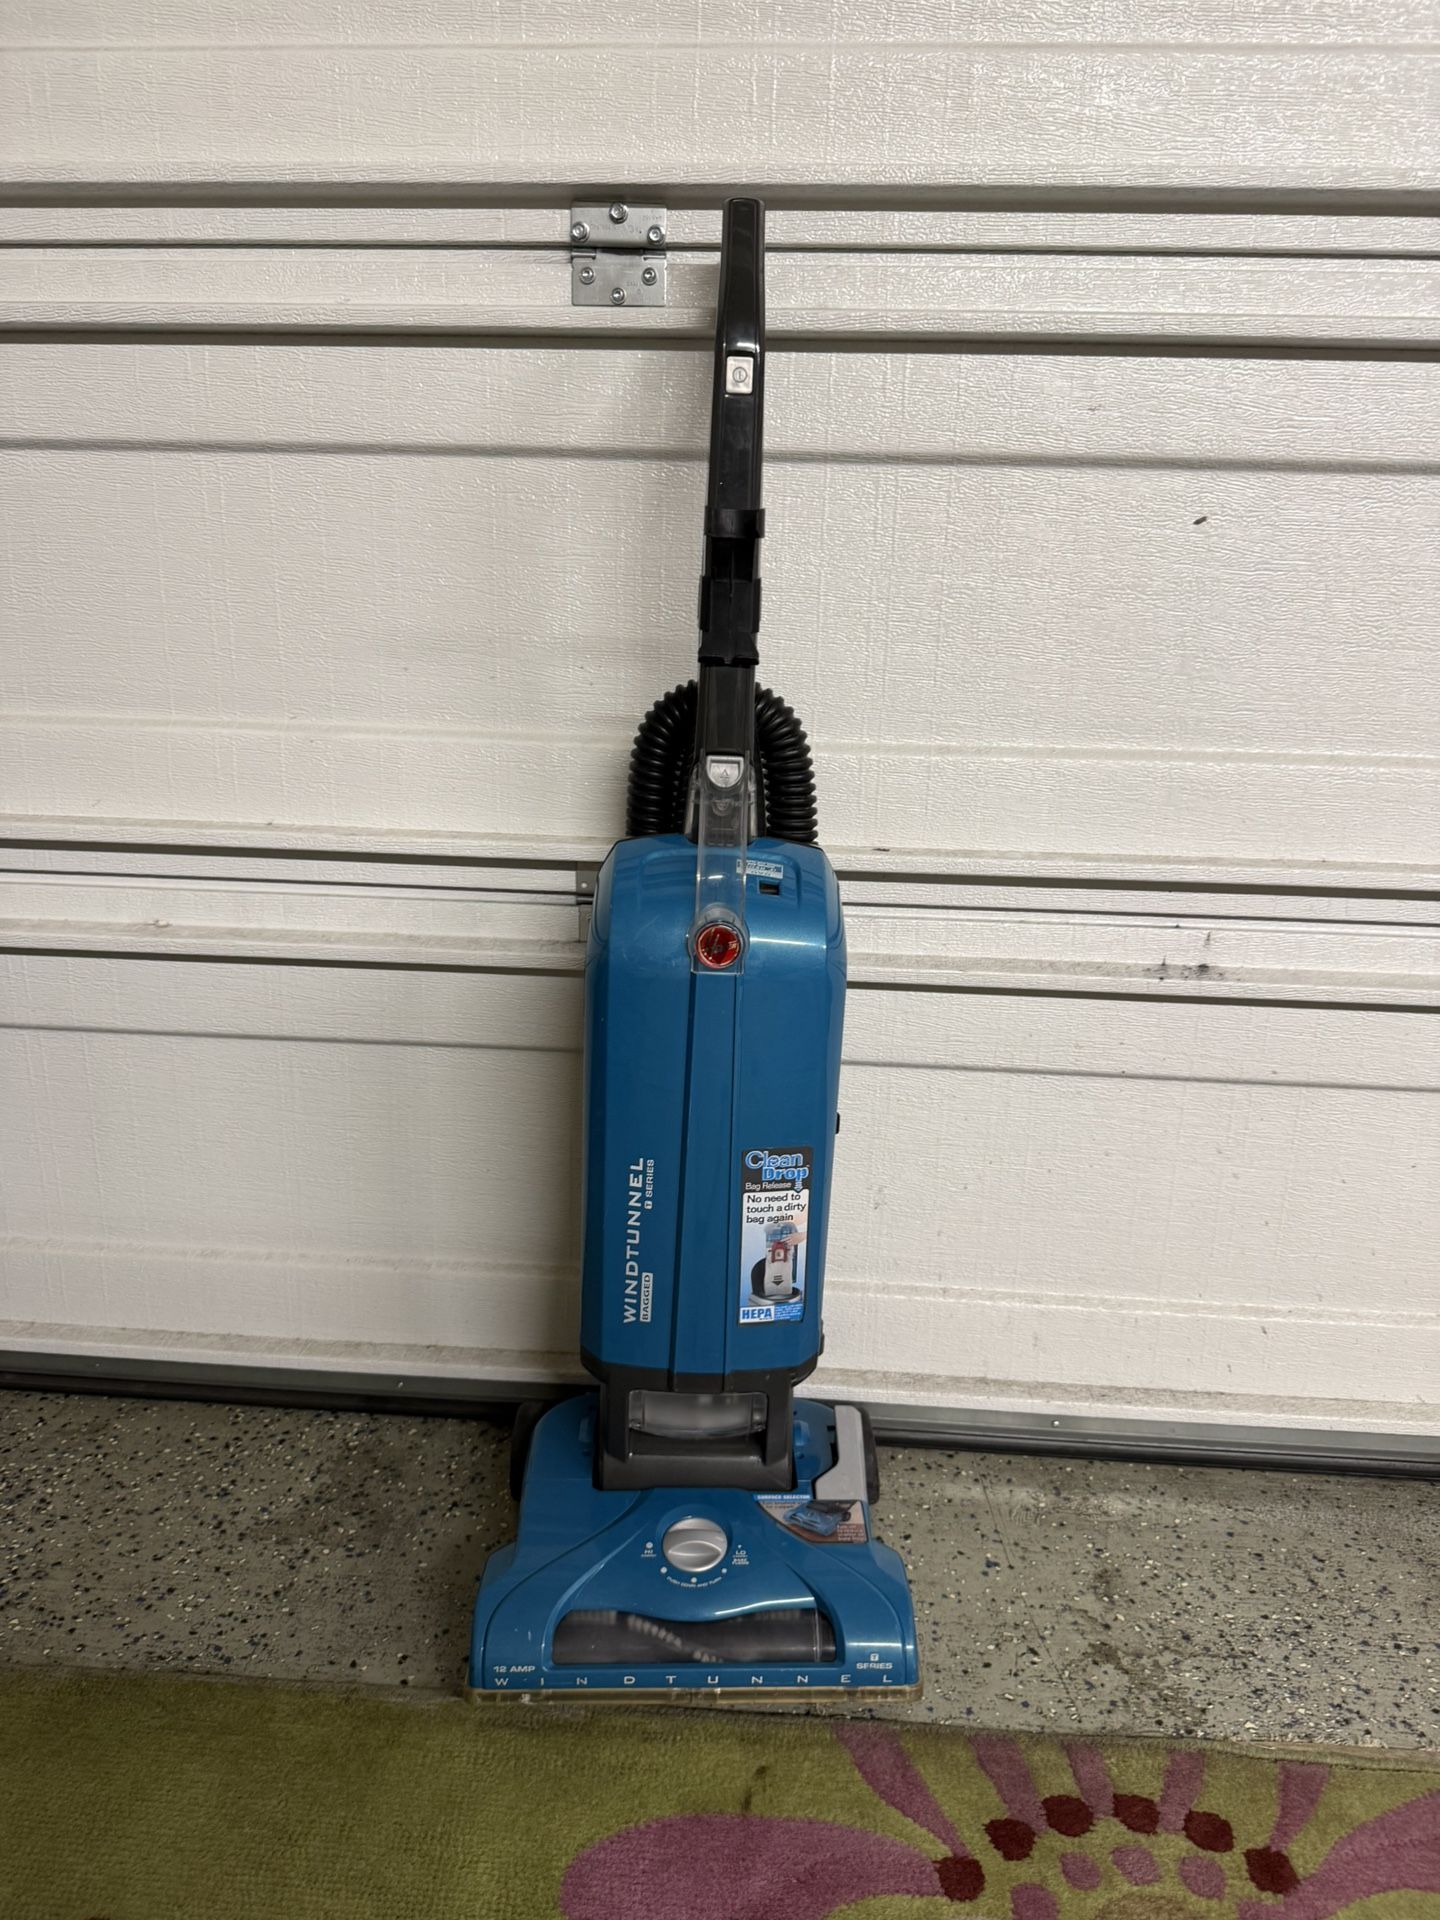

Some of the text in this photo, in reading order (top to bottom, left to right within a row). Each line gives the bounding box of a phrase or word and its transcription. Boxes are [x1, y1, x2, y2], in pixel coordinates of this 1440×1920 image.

[745, 1151, 804, 1170] Clean
[645, 1159, 655, 1198] SERIES
[762, 1167, 809, 1181] Drop
[745, 1181, 792, 1191] Bag Release
[747, 1193, 801, 1203] No need to
[746, 1204, 774, 1214] touch
[784, 1202, 807, 1212] dirty
[746, 1213, 794, 1224] bag again
[623, 1157, 643, 1324] WINDTUNNEL
[642, 1274, 651, 1321] BAGGED
[742, 1308, 773, 1319] HEPA
[493, 1665, 536, 1673] 12 AMP
[856, 1662, 893, 1670] SERIES
[494, 1674, 893, 1687] WINDTUNNEL
